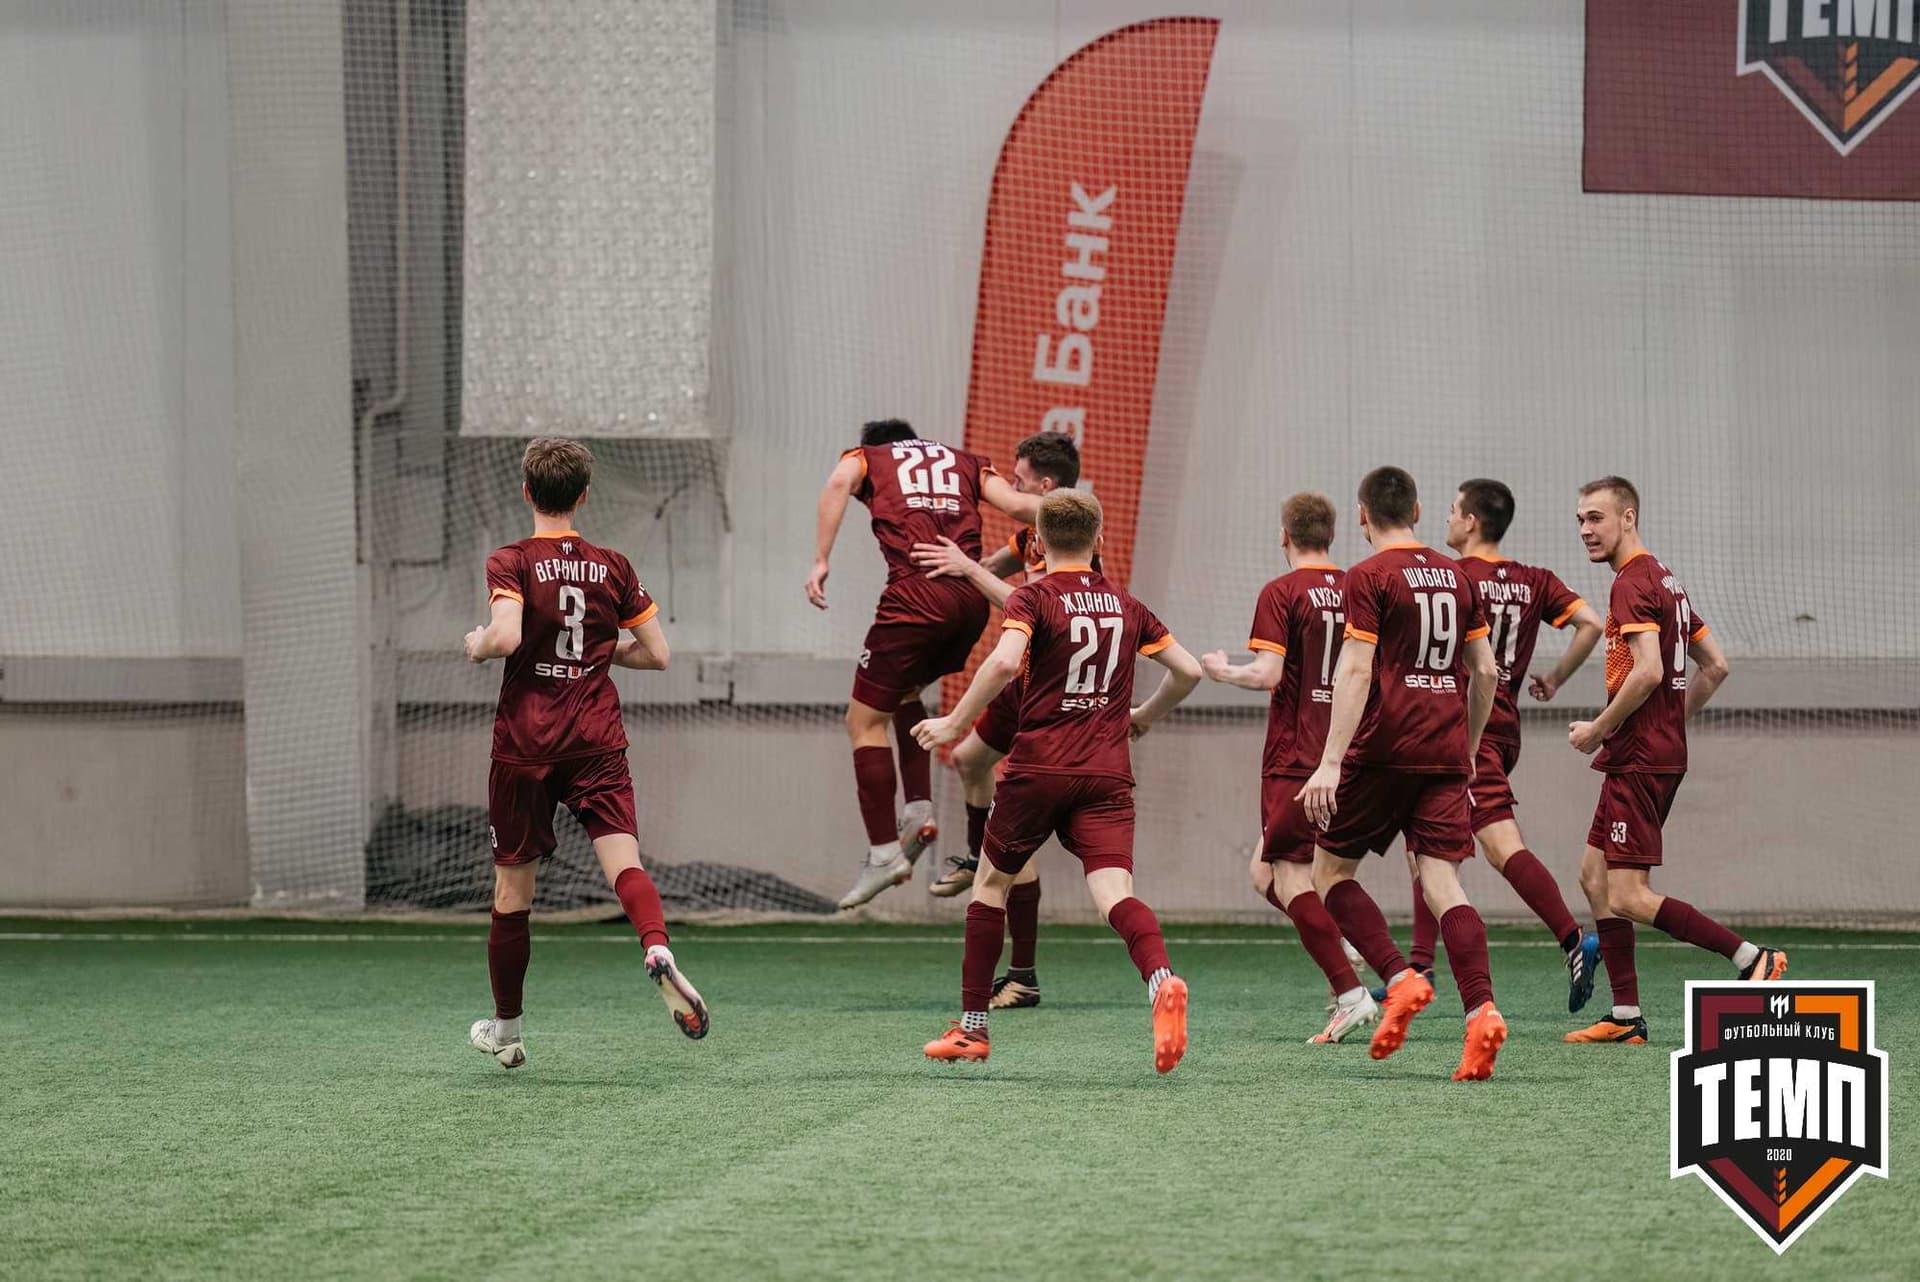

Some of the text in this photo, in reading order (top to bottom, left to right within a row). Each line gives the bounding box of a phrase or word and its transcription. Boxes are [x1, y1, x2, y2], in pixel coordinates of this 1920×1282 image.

[1033, 182, 1117, 386] Банк
[892, 447, 960, 494] 22
[535, 558, 608, 583] ВЕРНИГОР
[1402, 567, 1457, 589] ШИБАЕВ
[1060, 592, 1122, 615] ЖДАНОВ
[1478, 580, 1531, 604] РОДИЧЕВ
[555, 585, 586, 661] 3
[1413, 592, 1457, 670] 19
[1490, 603, 1521, 668] 11
[1065, 616, 1124, 693] 27
[1404, 674, 1456, 688] SEUS
[489, 824, 498, 849] 3
[1611, 821, 1627, 843] 33
